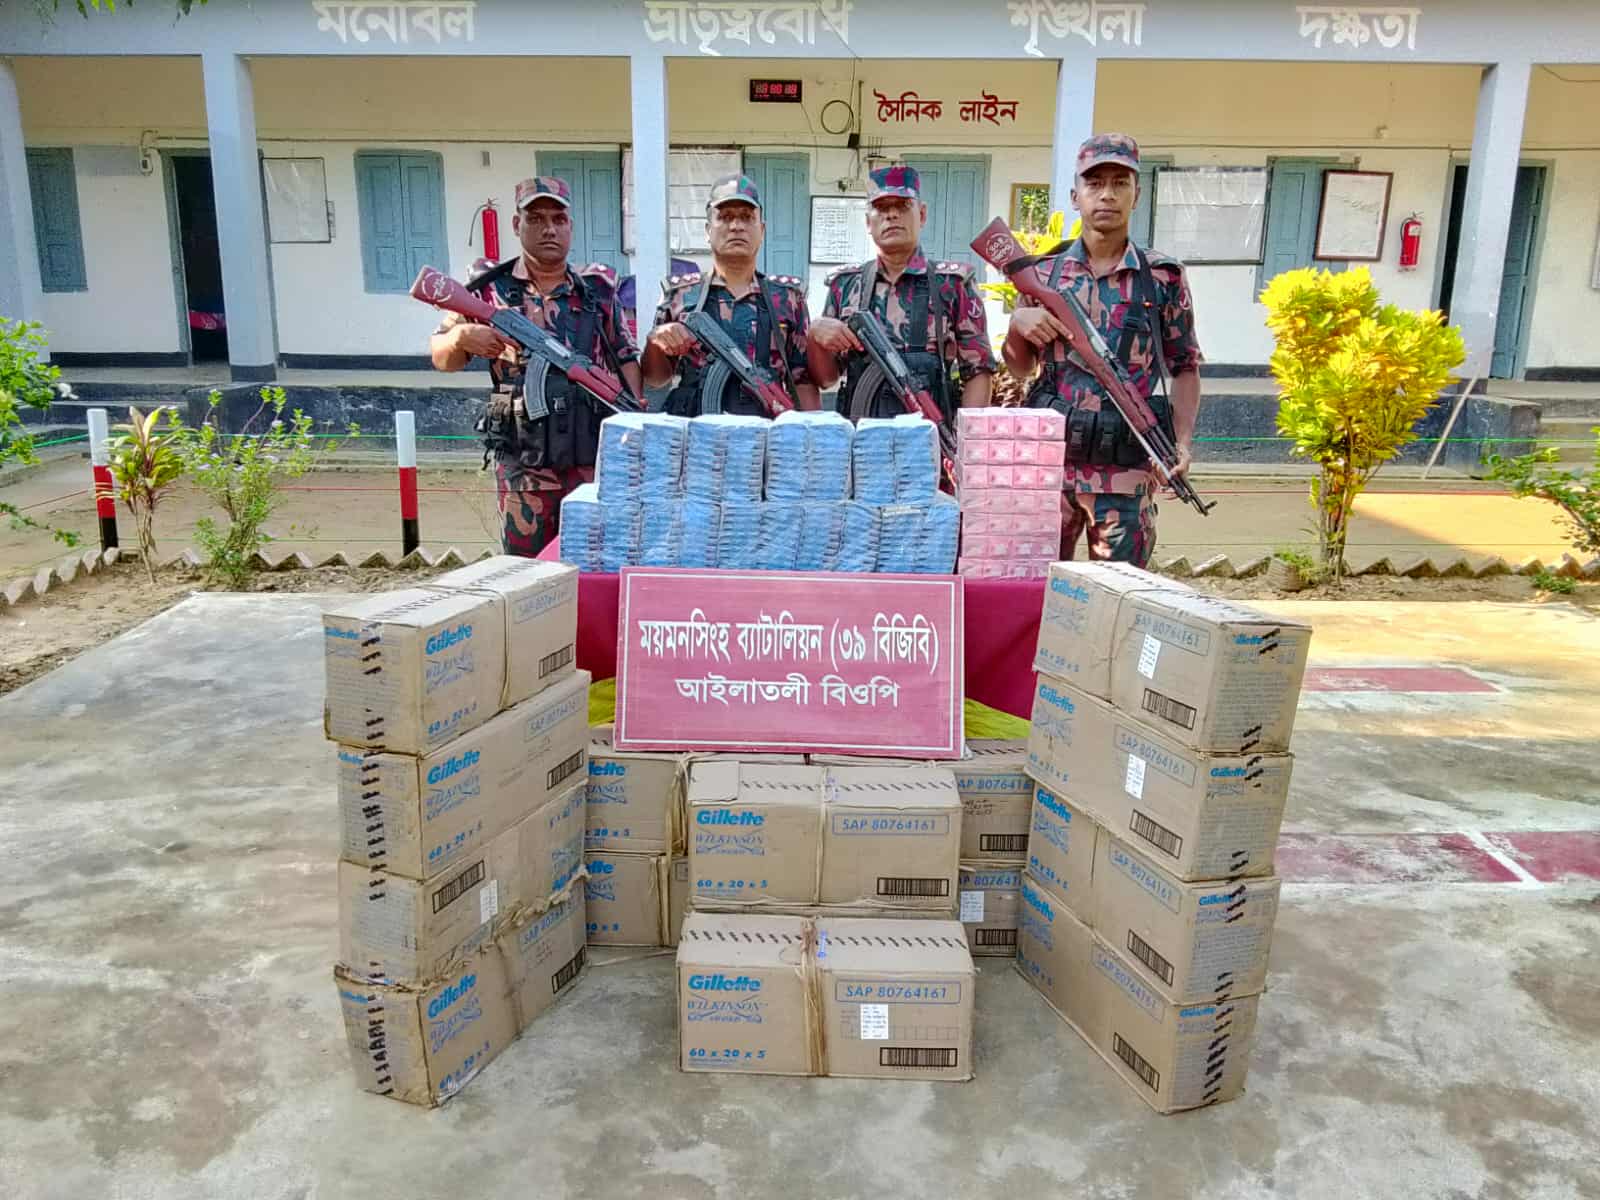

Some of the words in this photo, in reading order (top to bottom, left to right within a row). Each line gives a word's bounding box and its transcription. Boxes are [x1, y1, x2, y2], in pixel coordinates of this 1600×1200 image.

[312, 0, 477, 43] মনোবল
[1296, 6, 1424, 50] দক্ষতা
[873, 88, 943, 122] সৈনিক
[958, 90, 1019, 126] লাইন
[1051, 576, 1089, 604] Gillette
[425, 623, 473, 656] Gillette
[638, 608, 731, 663] ময়মনসিংহ
[736, 609, 824, 662] ব্যাটালিয়ন
[831, 618, 866, 672] (৩৯
[872, 612, 939, 675] বিজিবি)
[675, 672, 812, 705] আইলাতলী
[820, 675, 901, 708] বিওপি
[1039, 684, 1075, 715] Gillette
[427, 750, 480, 785] Gillette
[588, 760, 626, 776] lette
[959, 777, 974, 789] AP
[976, 777, 1031, 790] 8076416
[697, 808, 764, 826] Gillette
[1037, 788, 1071, 823] Gillette
[842, 818, 868, 831] SAP
[872, 818, 936, 832] 80764161
[697, 880, 712, 889] 60
[728, 879, 745, 889] 20
[760, 879, 768, 889] 5
[1022, 884, 1055, 922] Gillette
[428, 973, 477, 1019] Gillette
[688, 974, 761, 992] Gillette
[847, 985, 873, 998] SAP
[878, 985, 947, 999] 80764161
[689, 1047, 705, 1058] 60
[711, 1050, 718, 1058] x
[723, 1048, 740, 1058] 20
[744, 1051, 752, 1059] x
[756, 1049, 767, 1060] 5
